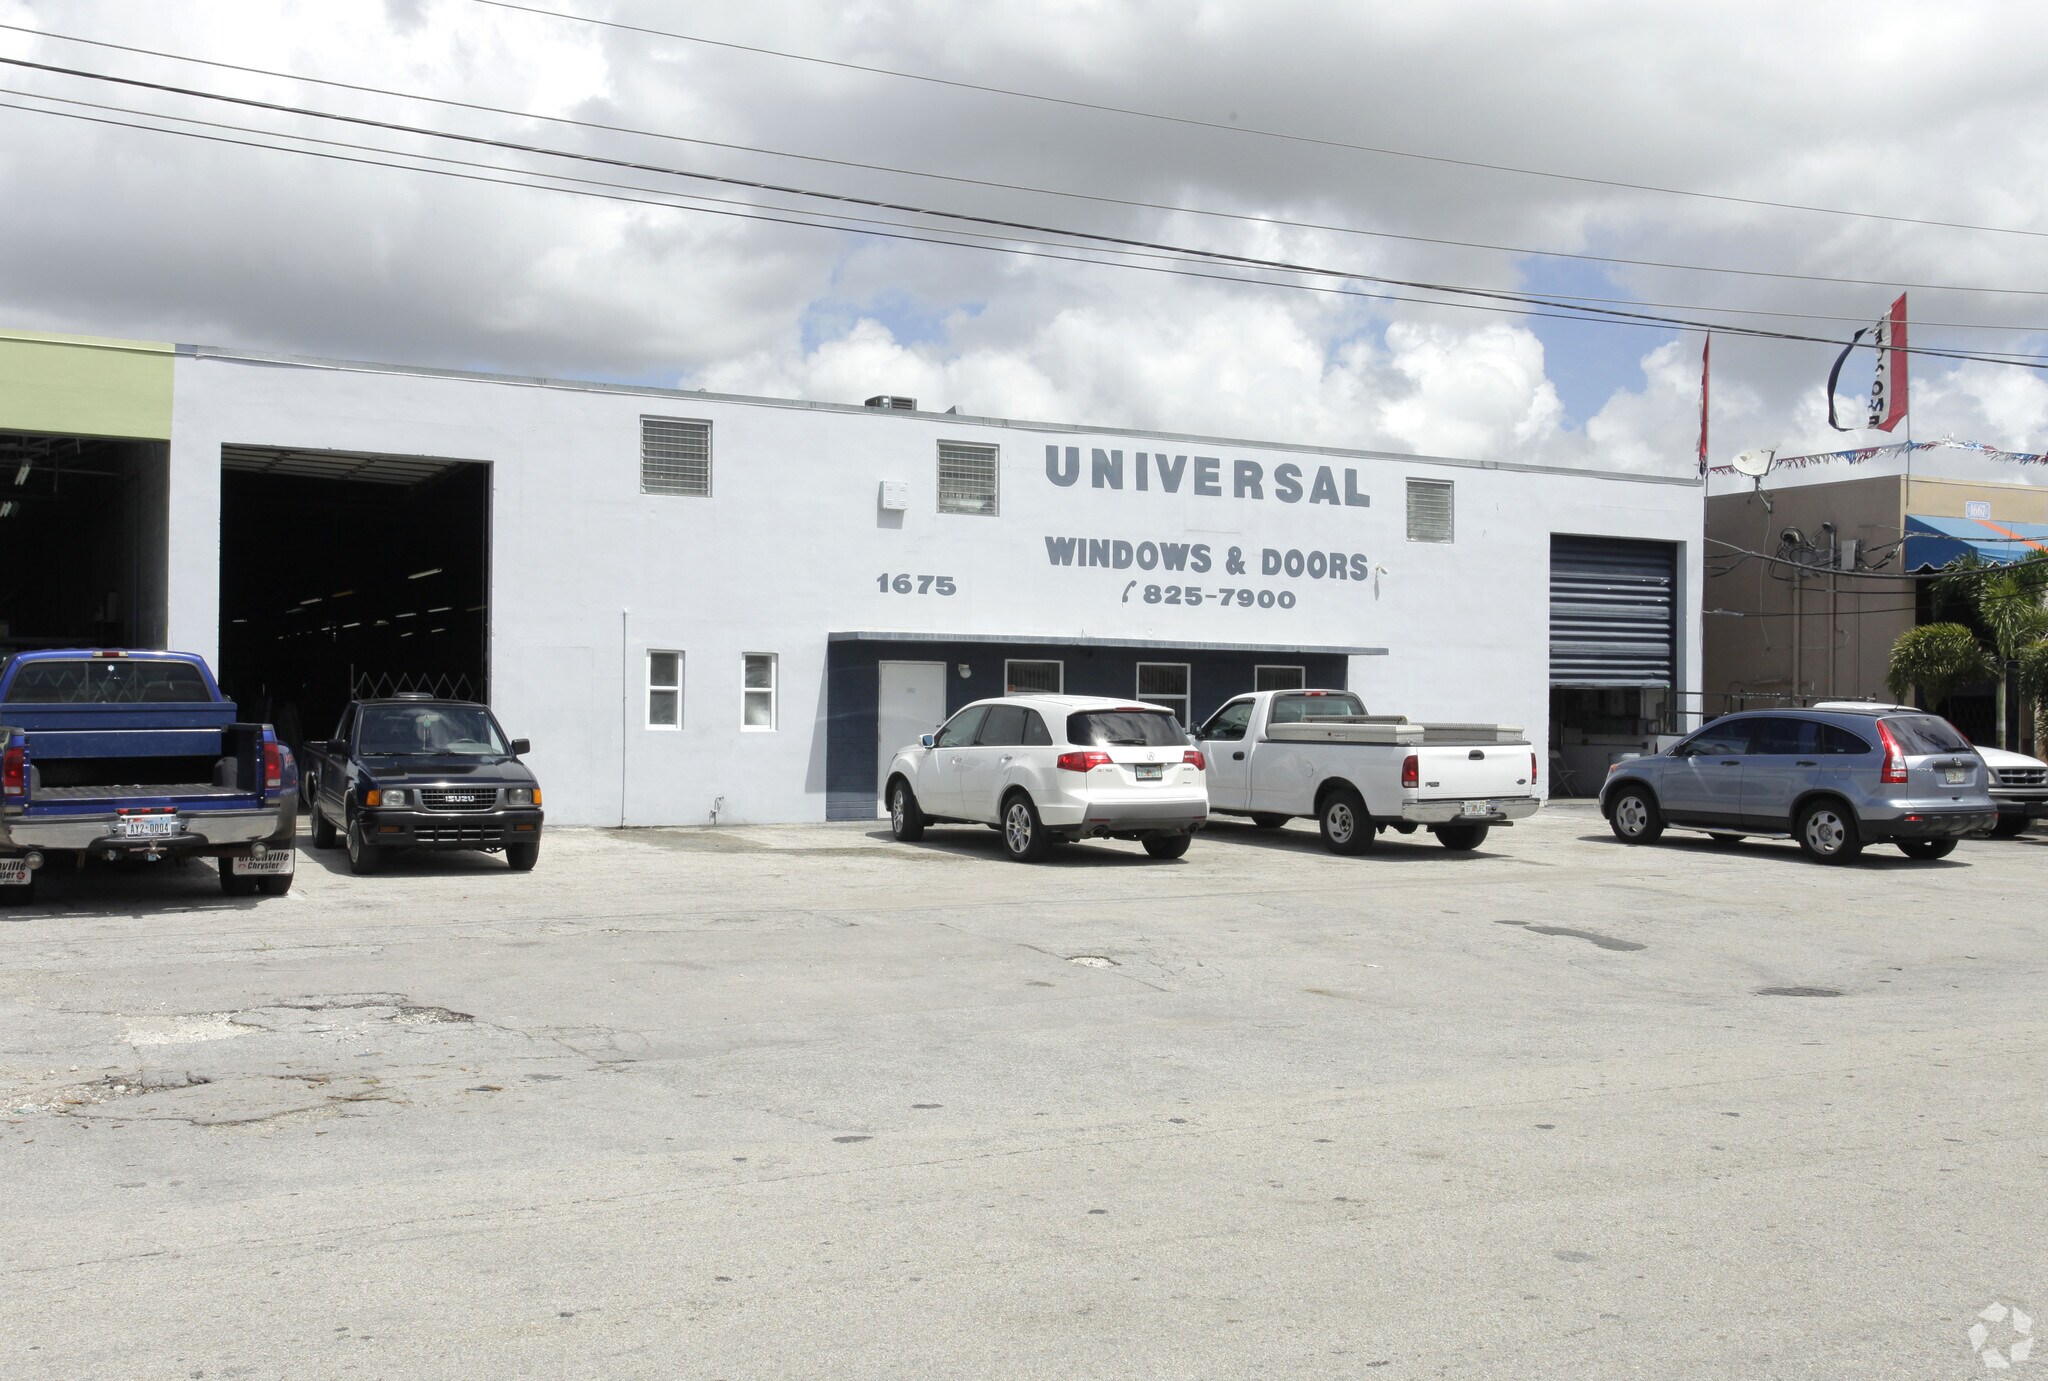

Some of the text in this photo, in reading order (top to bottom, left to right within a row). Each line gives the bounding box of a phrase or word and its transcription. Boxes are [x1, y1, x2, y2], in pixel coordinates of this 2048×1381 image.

[1045, 445, 1370, 508] UNIVERSAL
[1970, 504, 1986, 517] 1667
[1044, 536, 1369, 581] WINDOWS & DOORS
[876, 573, 957, 596] 1675
[1143, 584, 1297, 609] 825-7900
[247, 861, 280, 870] Chrysler
